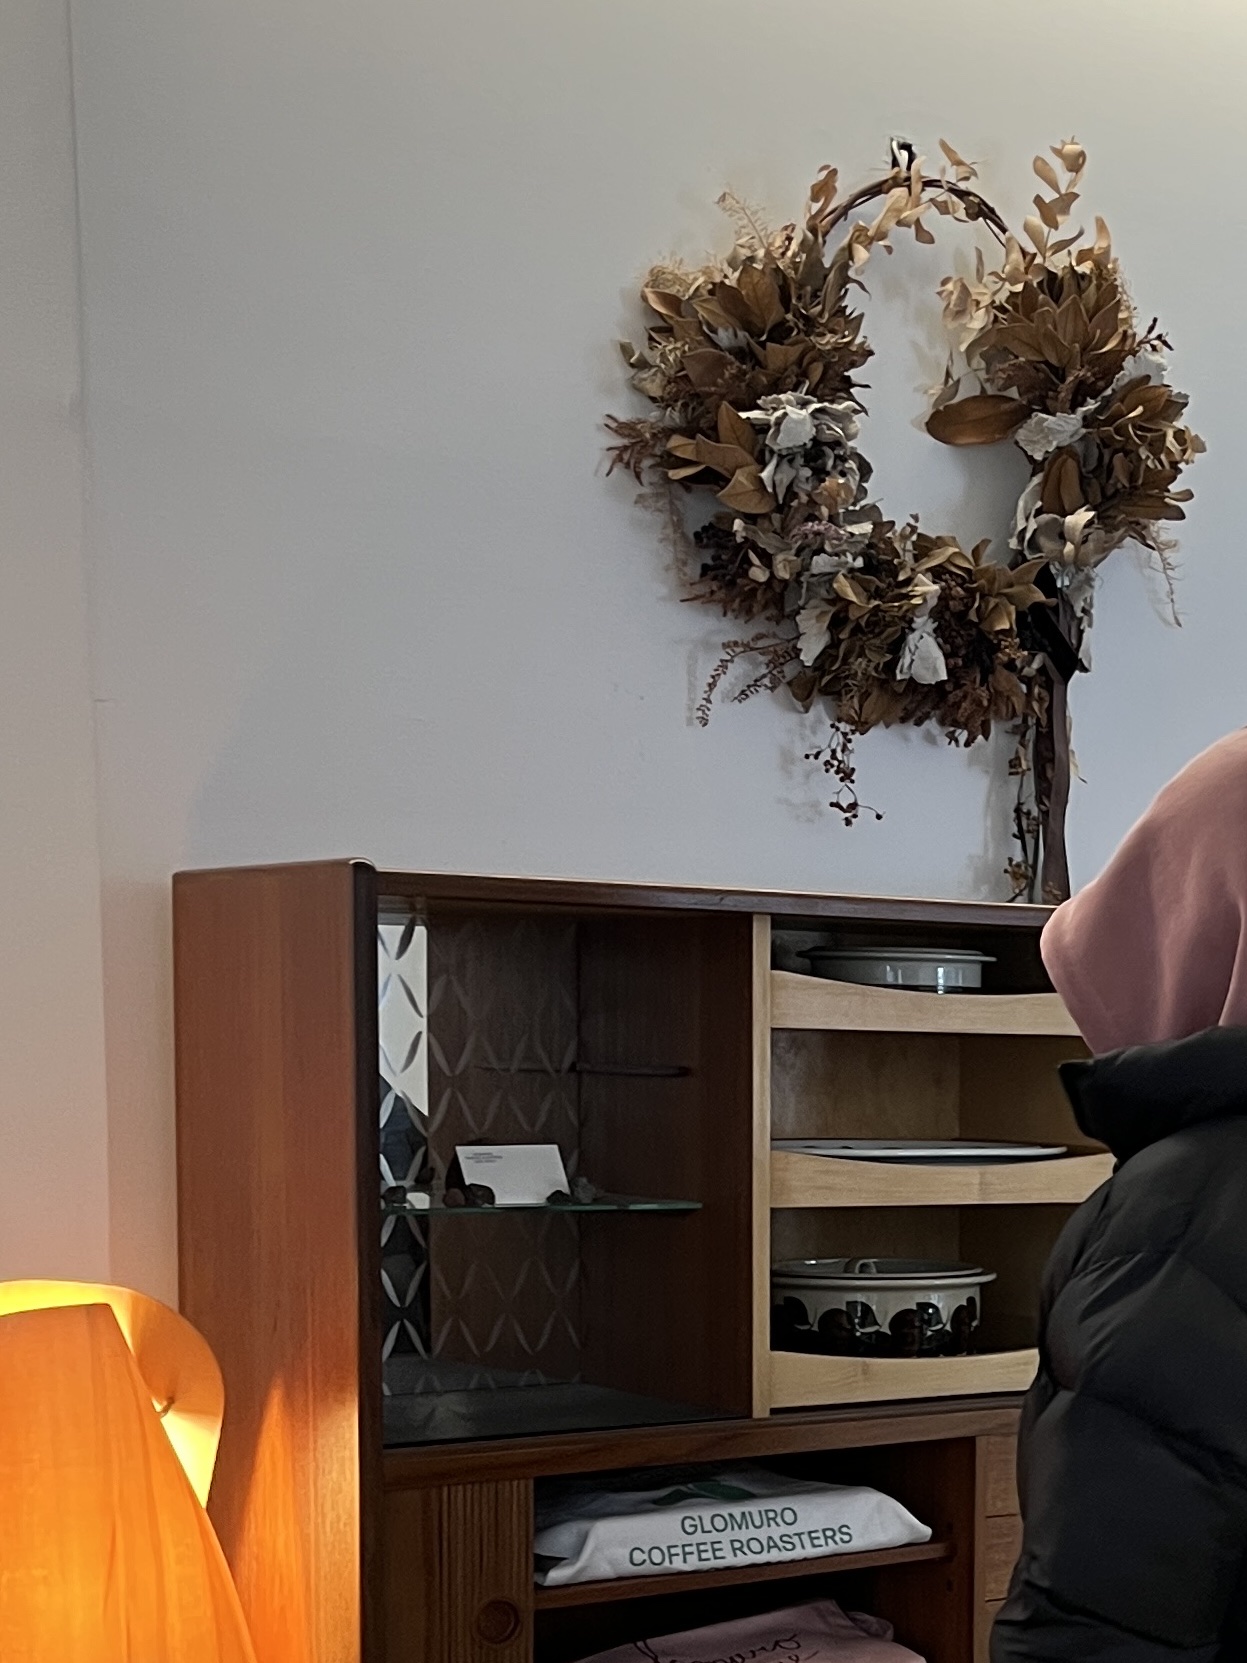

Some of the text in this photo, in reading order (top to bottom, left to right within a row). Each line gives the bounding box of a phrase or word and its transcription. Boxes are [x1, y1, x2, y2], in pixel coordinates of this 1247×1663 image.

[681, 1507, 798, 1536] GLOMURO
[628, 1524, 854, 1567] COFFEE ROASTERS
